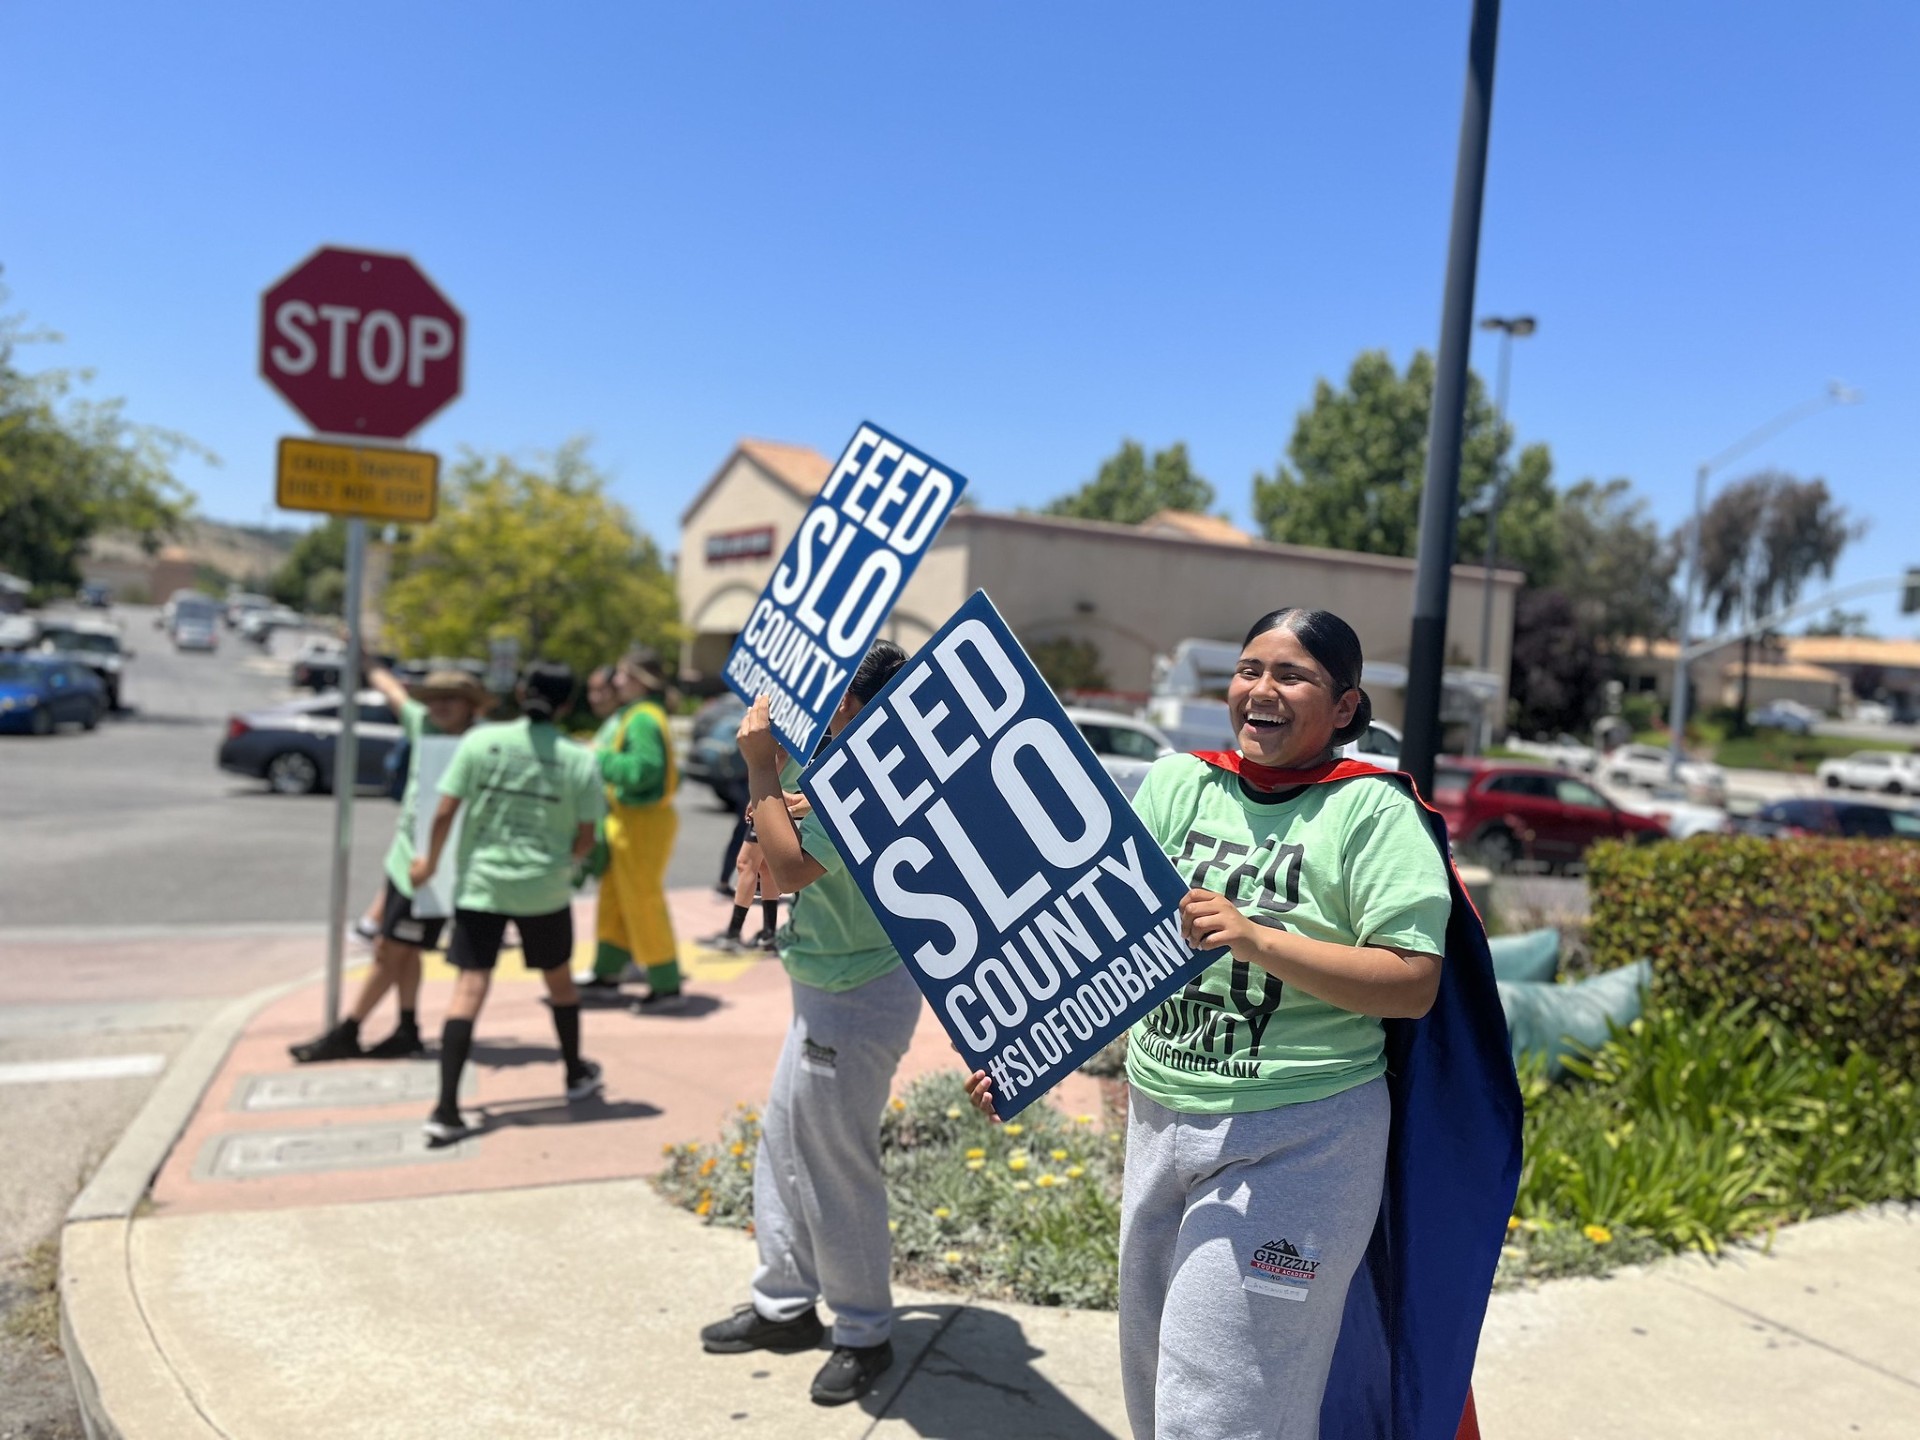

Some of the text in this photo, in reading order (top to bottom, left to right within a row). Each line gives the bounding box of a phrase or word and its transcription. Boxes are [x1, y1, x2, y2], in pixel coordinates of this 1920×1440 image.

[271, 299, 455, 388] STOP
[821, 425, 954, 556] FEED
[772, 505, 903, 658] SLO
[744, 599, 847, 713] COUNTY
[809, 618, 1026, 865] FEED
[873, 717, 1112, 980] SLO
[944, 836, 1162, 1053] COUNTY
[988, 908, 1195, 1102] #SLOFOODBANK
[1253, 1249, 1320, 1272] GRIZZLY
[1256, 1262, 1281, 1273] YOUTH
